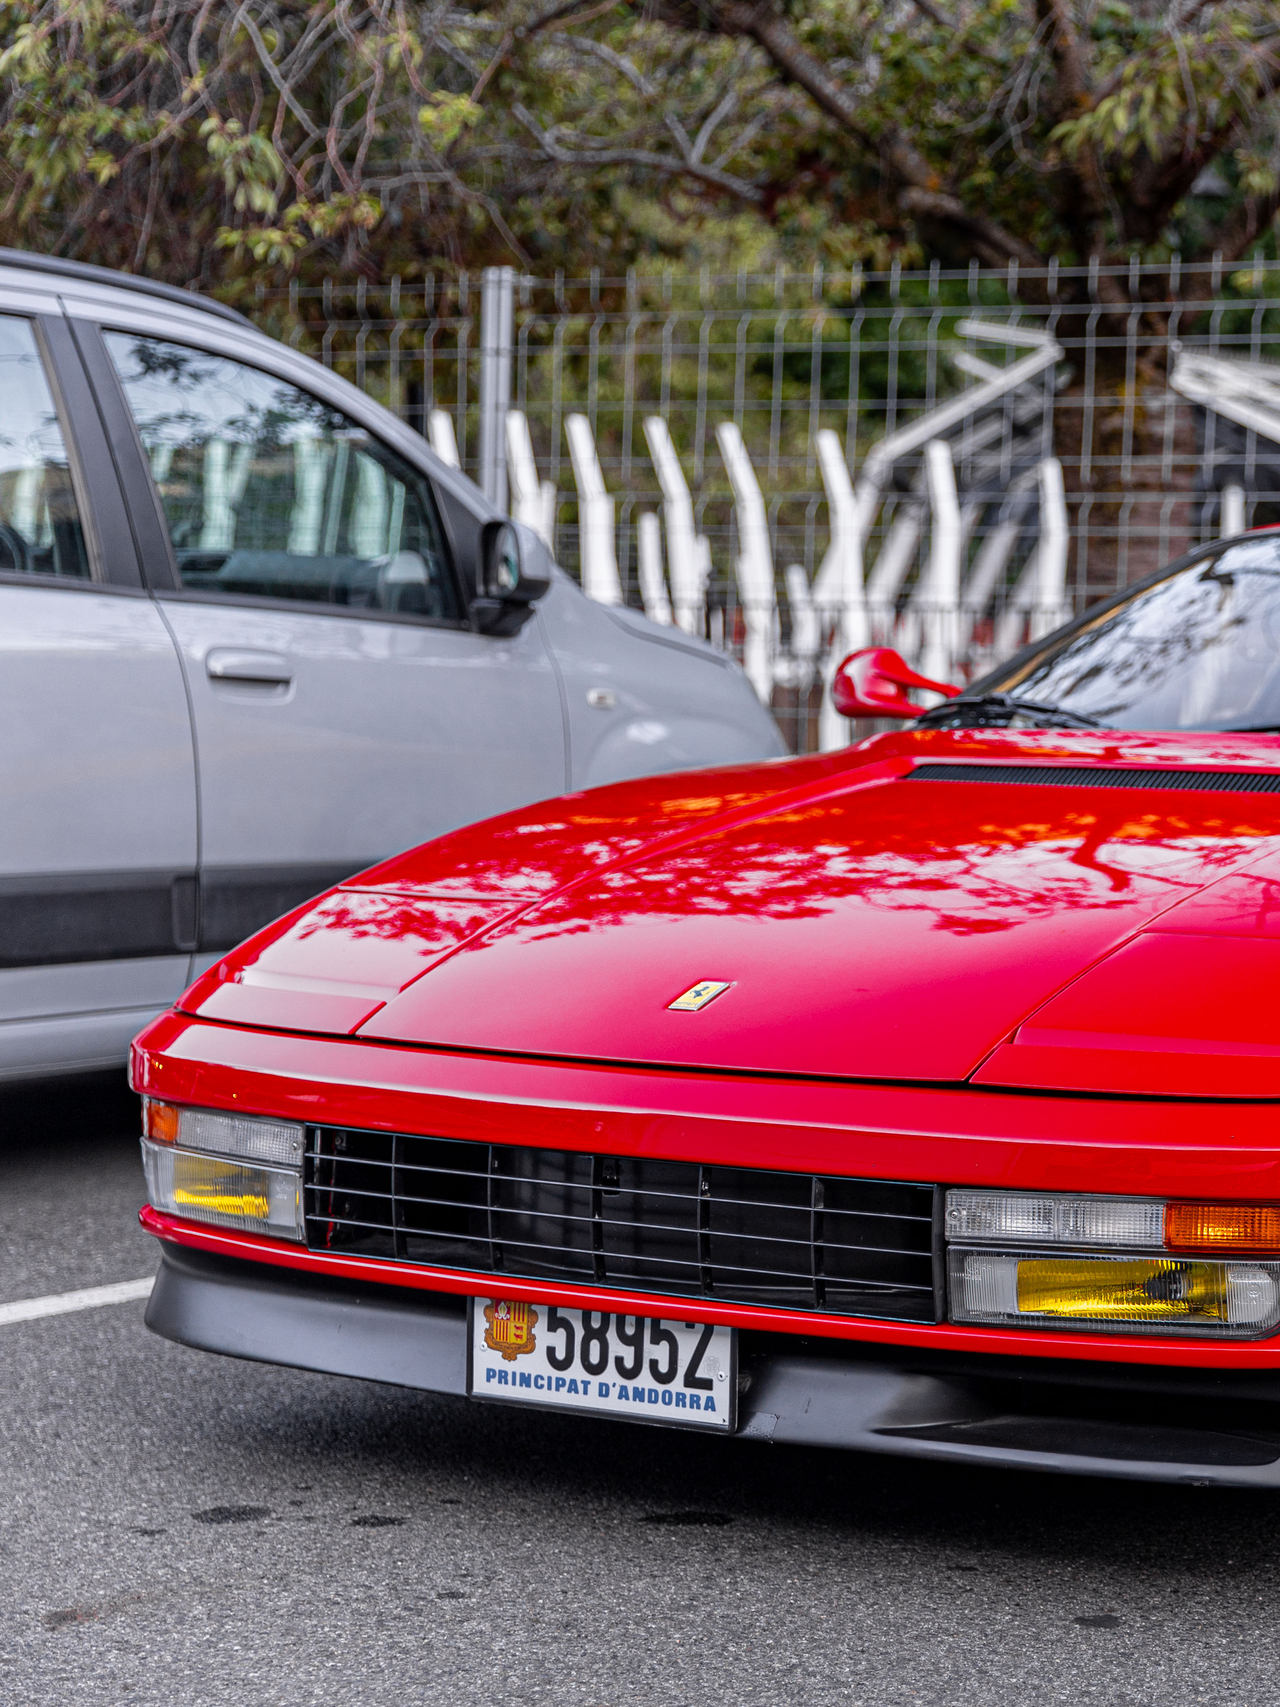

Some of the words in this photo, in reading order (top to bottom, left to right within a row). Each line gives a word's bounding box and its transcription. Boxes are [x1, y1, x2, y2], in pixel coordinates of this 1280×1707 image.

[546, 1306, 713, 1391] 58952
[485, 1367, 591, 1396] PRINCIPAT
[598, 1381, 717, 1412] D'ANDORRA
